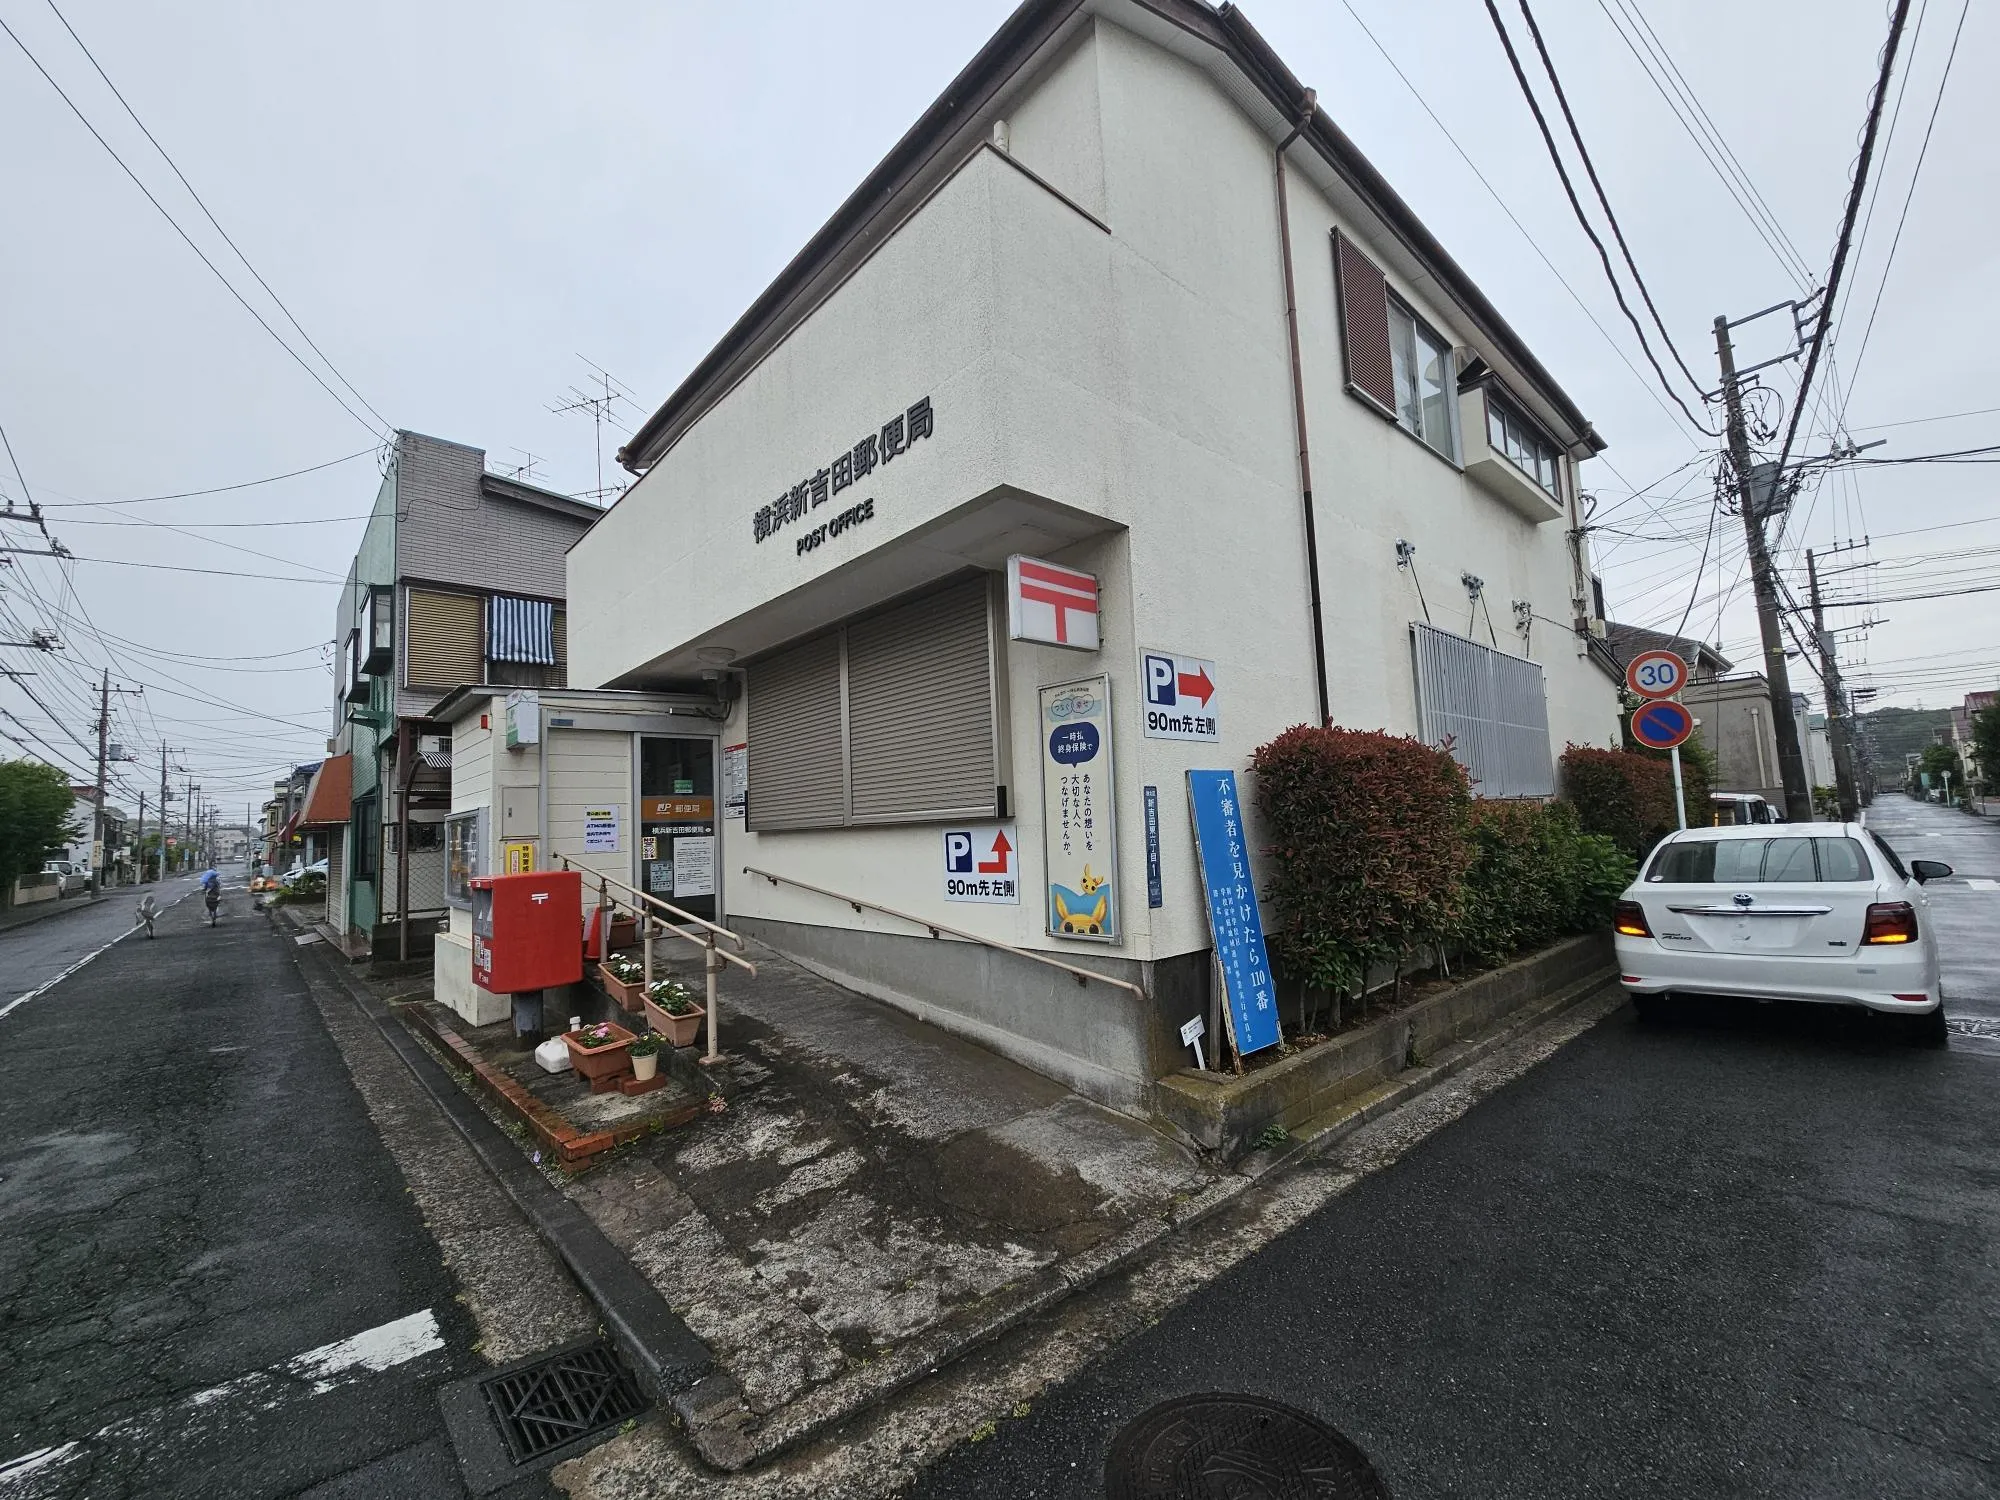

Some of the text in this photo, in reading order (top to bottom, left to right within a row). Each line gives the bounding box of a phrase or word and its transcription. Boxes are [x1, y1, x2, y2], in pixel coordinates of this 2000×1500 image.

[753, 396, 933, 543] 横浜新吉田郵便局
[796, 497, 874, 556] POST OFFICE
[1148, 658, 1173, 701] P
[1641, 664, 1674, 686] 30
[1058, 742, 1093, 753] 終身保険で
[1062, 731, 1083, 741] 一時払
[1061, 776, 1072, 856] つなげませんか。
[1071, 774, 1081, 828] 大切な人へ
[1083, 774, 1093, 851] あなたの想いを
[652, 826, 704, 835] 横浜新吉田郵便局
[947, 835, 970, 871] P
